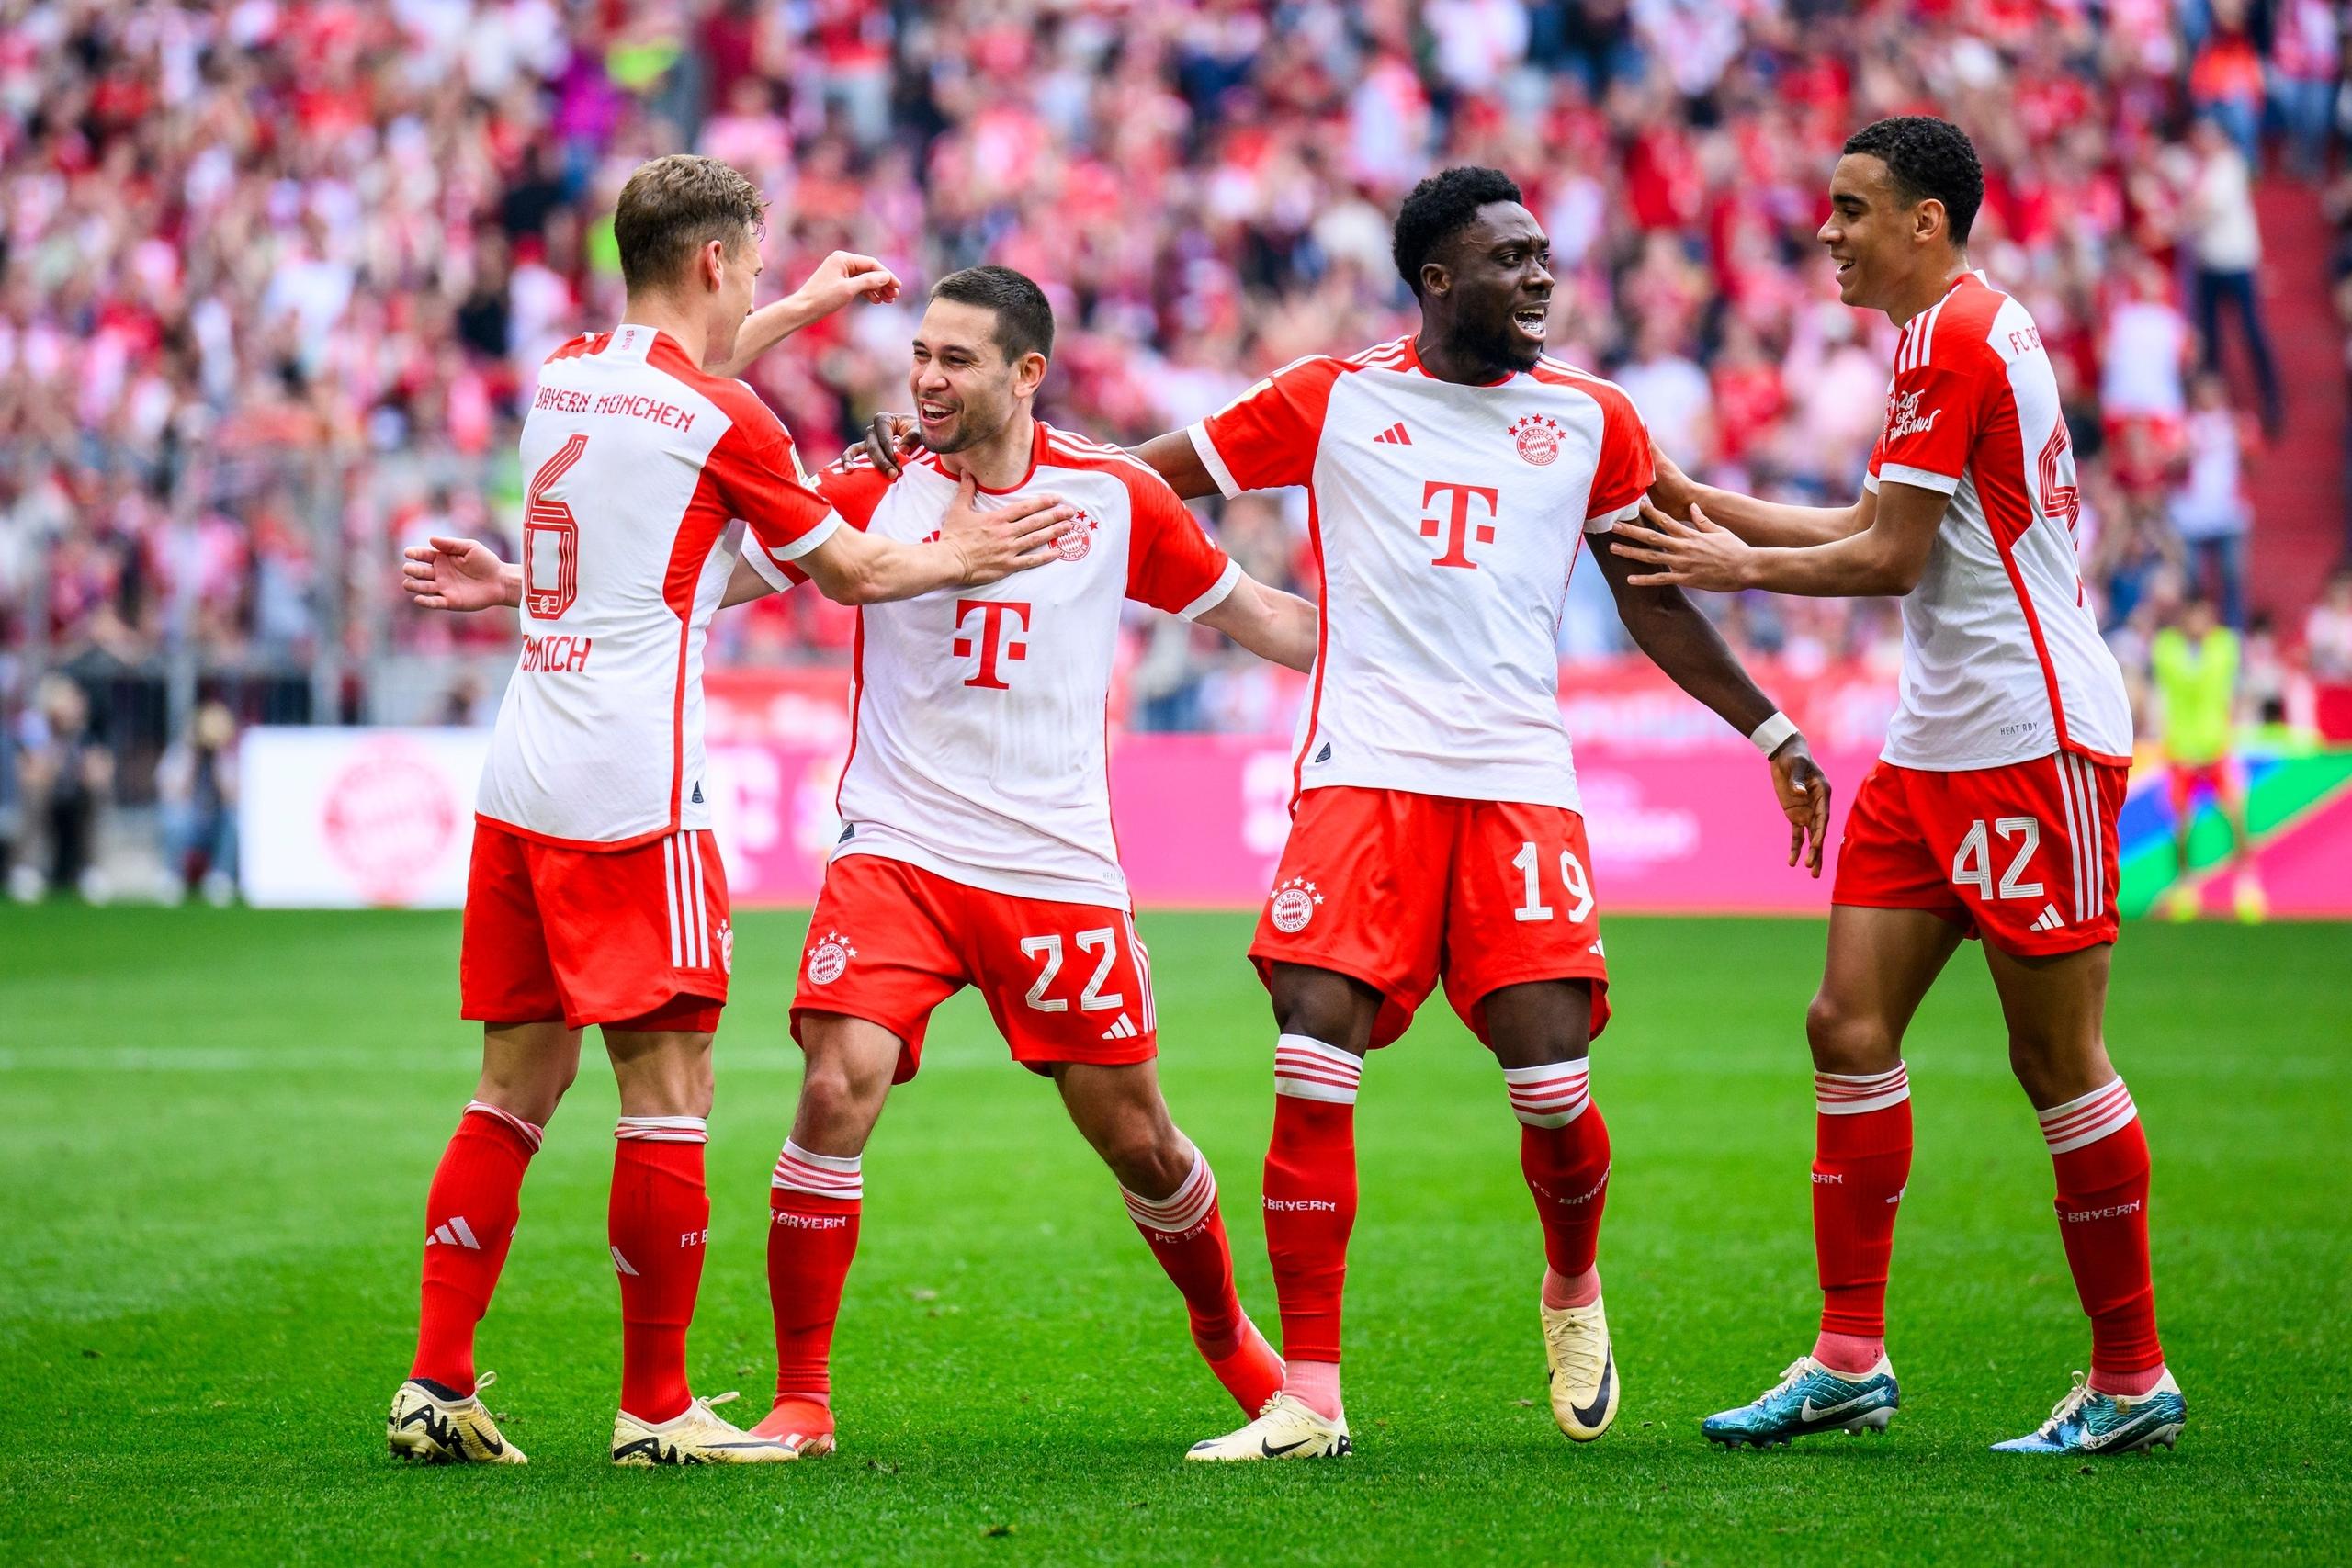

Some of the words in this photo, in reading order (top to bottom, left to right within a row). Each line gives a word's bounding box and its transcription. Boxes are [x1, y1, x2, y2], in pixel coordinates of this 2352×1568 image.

[2009, 331, 2030, 355] FC
[535, 386, 592, 413] BAYERN
[594, 393, 695, 433] MÜNCHEN
[524, 434, 589, 621] 6
[1420, 480, 1499, 570] T
[953, 599, 1031, 690] T
[2000, 724, 2020, 736] HEAT
[2022, 721, 2038, 733] RDY
[1951, 816, 2045, 900] 42
[1511, 841, 1595, 923] 19
[1286, 892, 1309, 909] BAYERN
[1020, 927, 1124, 1012] 22
[776, 1212, 847, 1230] BAYERN
[1267, 1197, 1336, 1213] BAYERN
[2067, 1200, 2140, 1223] BAYERN
[680, 1231, 698, 1248] FC
